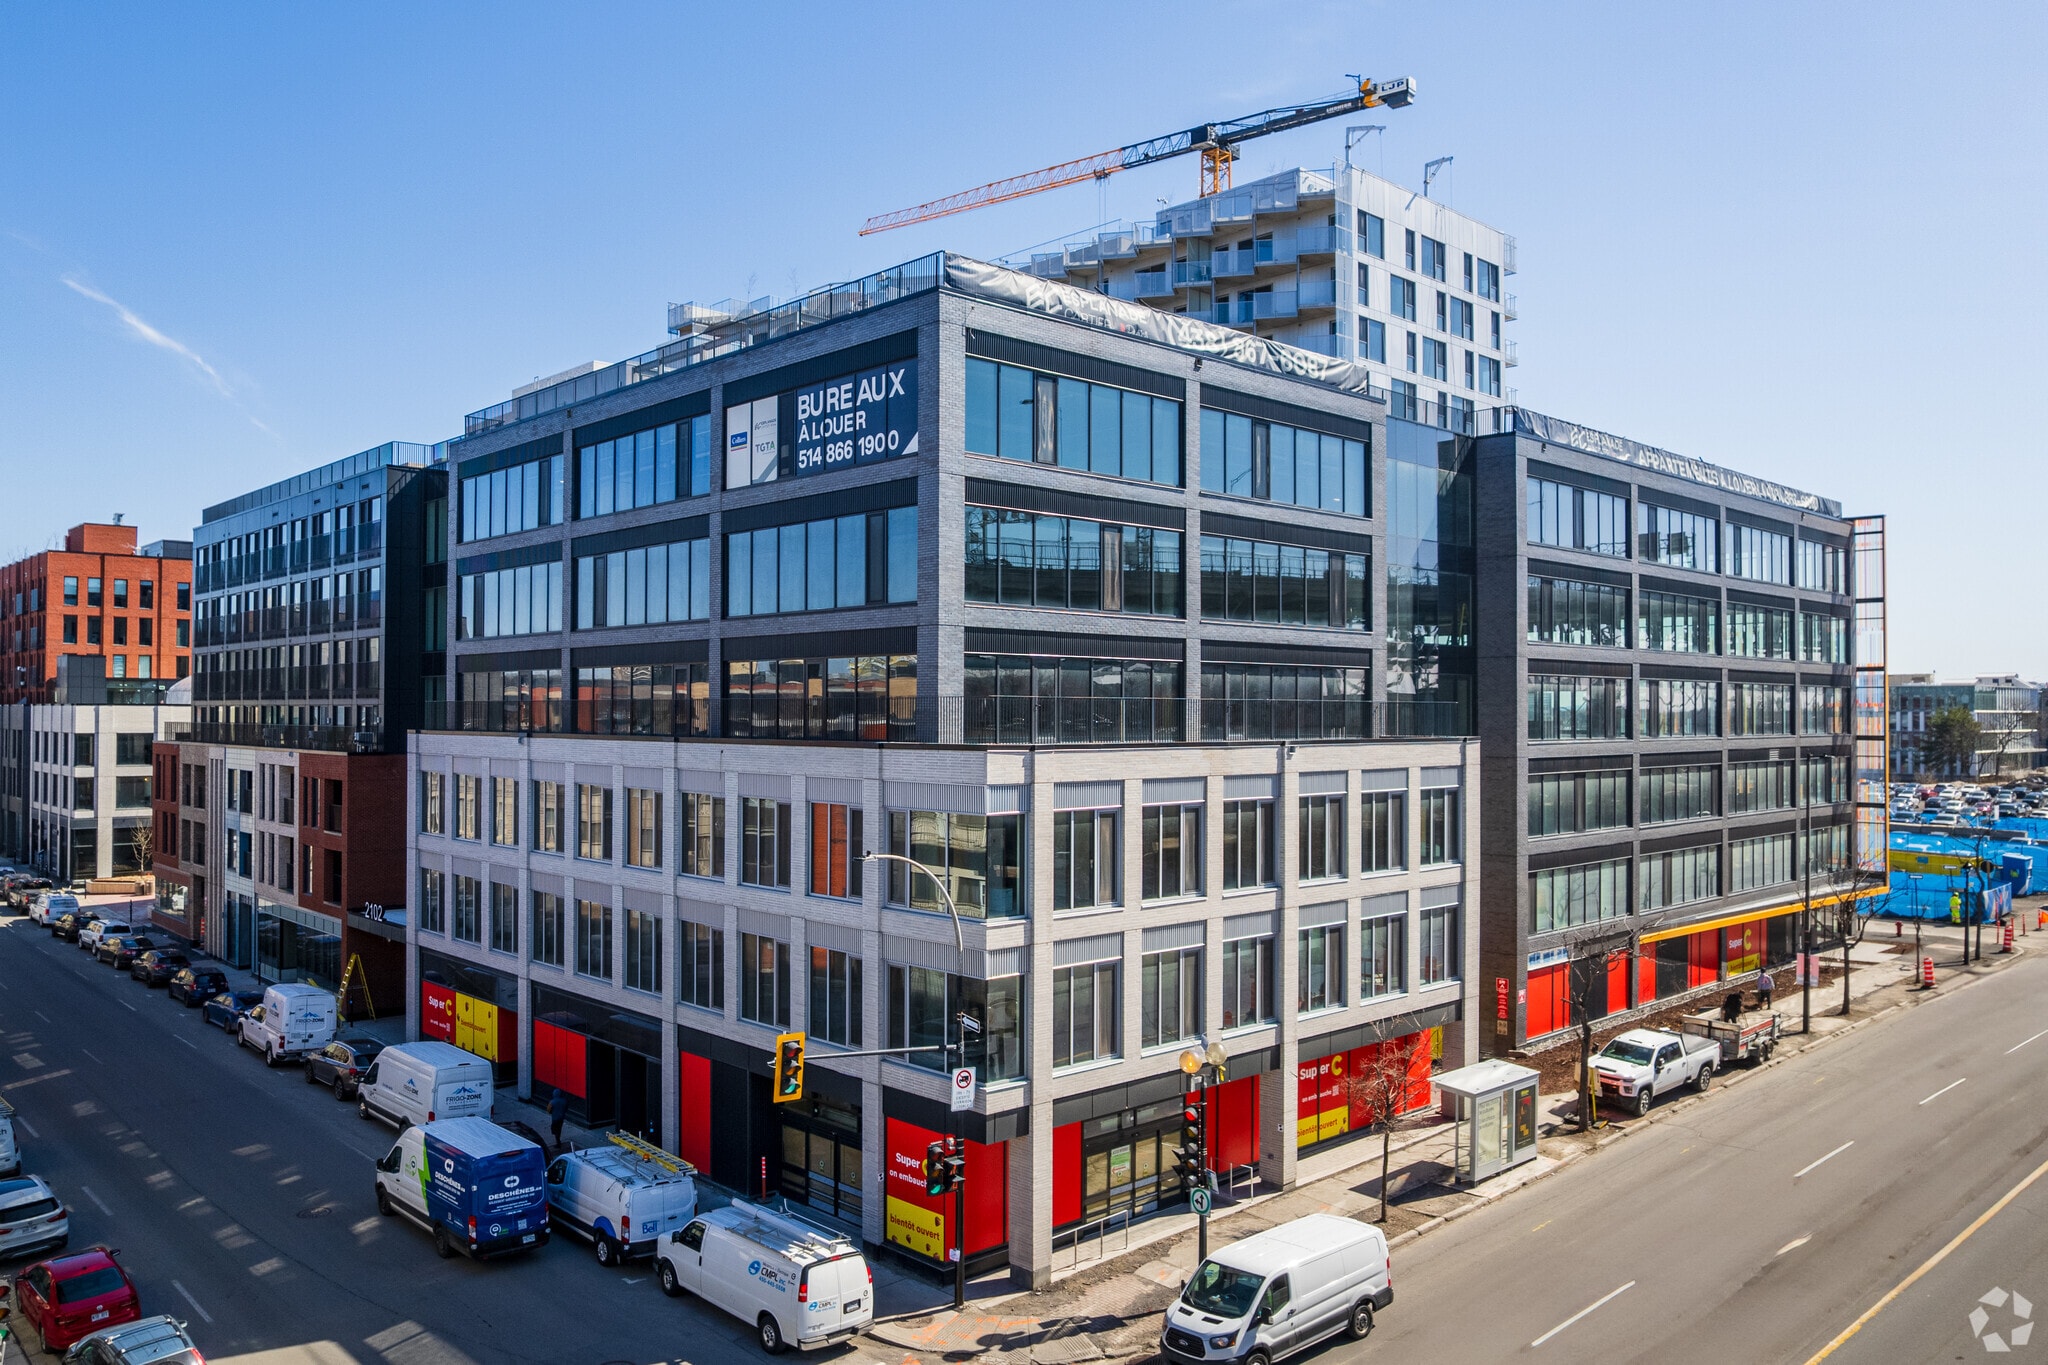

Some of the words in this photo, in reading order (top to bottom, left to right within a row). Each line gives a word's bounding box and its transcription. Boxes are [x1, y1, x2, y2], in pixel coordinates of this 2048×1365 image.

[1381, 81, 1404, 92] LJP
[1062, 288, 1147, 323] ESPLANADE
[798, 368, 906, 420] BUREAUX
[798, 421, 810, 443] À
[812, 410, 867, 440] LOUER
[755, 440, 776, 453] TGTA
[798, 446, 823, 469] 514
[826, 438, 853, 463] 866
[857, 429, 899, 456] 1900
[365, 901, 383, 922] 2102
[1728, 938, 1743, 949] Super
[1743, 928, 1752, 951] C
[428, 995, 445, 1009] Super
[445, 999, 453, 1016] C
[1299, 1063, 1331, 1080] Super
[1331, 1055, 1343, 1076] C
[445, 1093, 482, 1103] FRIGO-ZONE
[895, 1152, 921, 1169] Super
[889, 1169, 897, 1178] on
[899, 1172, 928, 1188] embauch
[642, 1220, 658, 1234] Bell
[890, 1213, 915, 1232] bientôt
[916, 1226, 940, 1240] ouvert
[761, 1267, 778, 1282] CMPL
